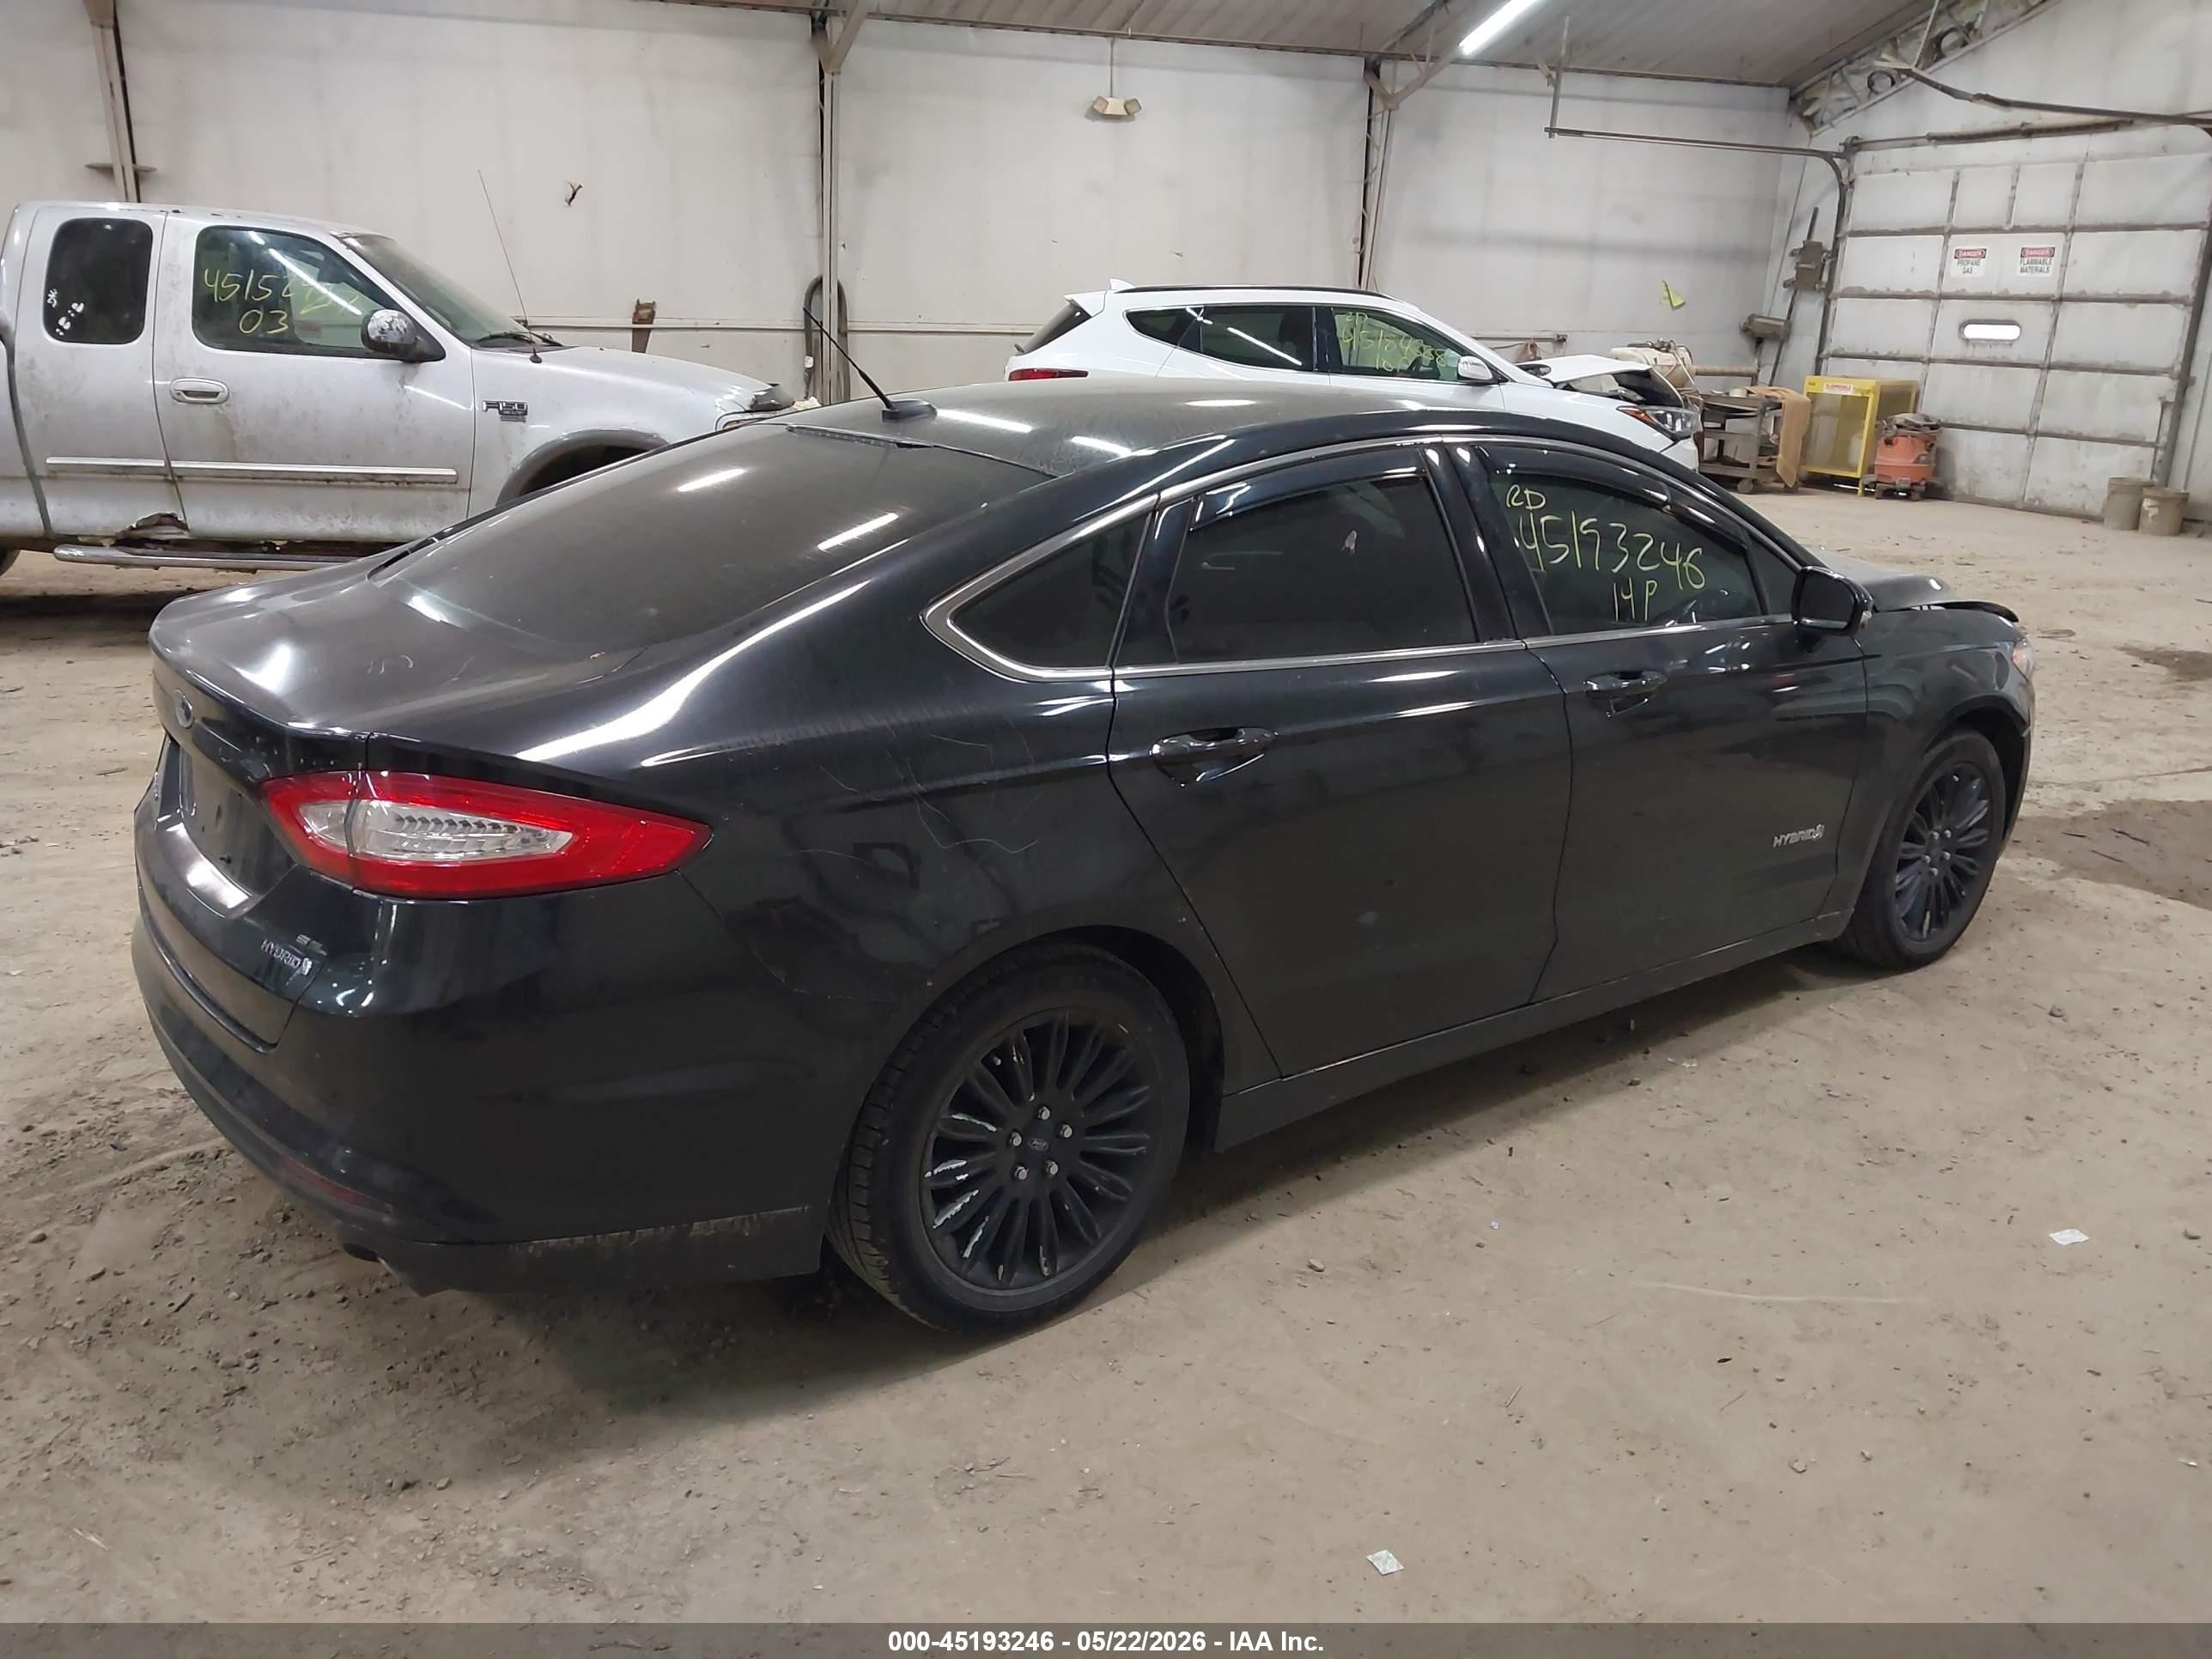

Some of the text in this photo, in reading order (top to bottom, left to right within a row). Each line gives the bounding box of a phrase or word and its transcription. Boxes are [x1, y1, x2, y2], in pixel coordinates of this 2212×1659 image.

[239, 309, 289, 334] 03
[1772, 829, 1815, 848] HYBRID
[260, 939, 302, 969] HYBRID
